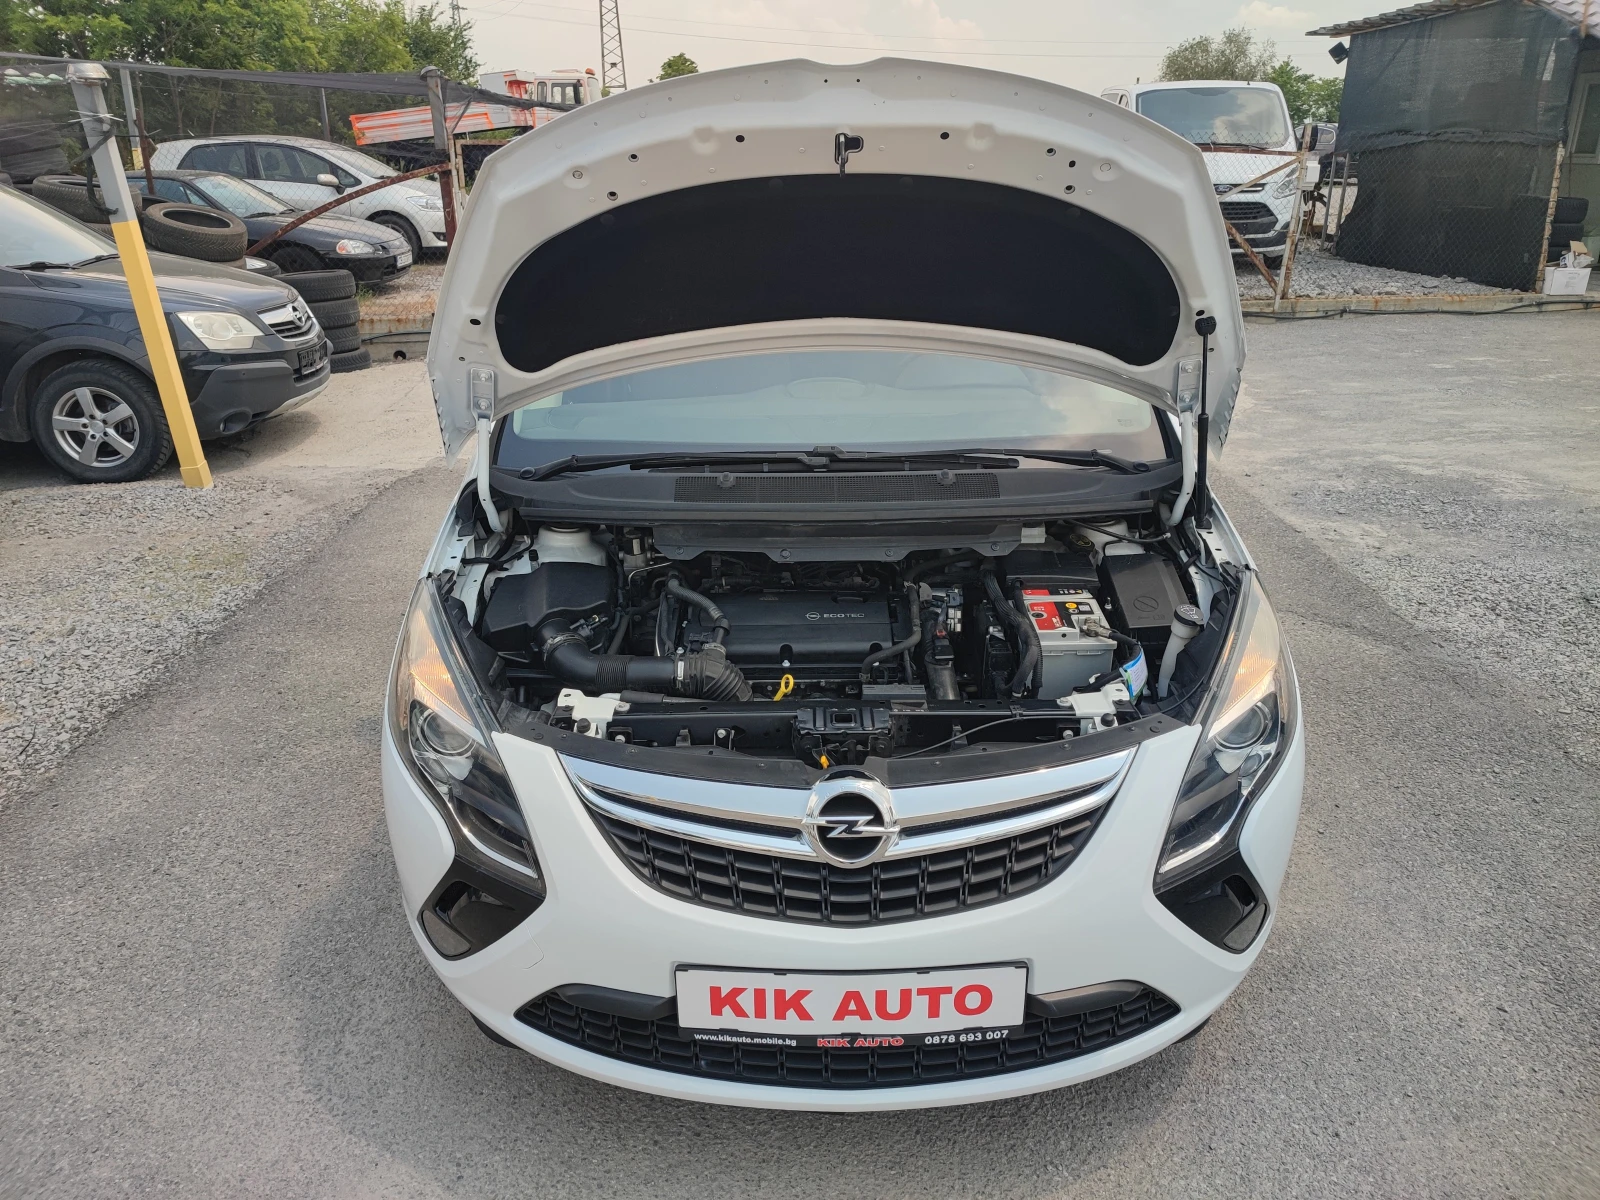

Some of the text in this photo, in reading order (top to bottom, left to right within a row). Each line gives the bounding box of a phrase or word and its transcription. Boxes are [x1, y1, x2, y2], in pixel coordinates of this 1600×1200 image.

[709, 984, 993, 1021] KIK AUTO
[693, 1033, 797, 1047] www.kikauto.mobile.bg
[817, 1037, 905, 1047] KIK AUTO
[924, 1030, 1009, 1045] 0878 693 007
